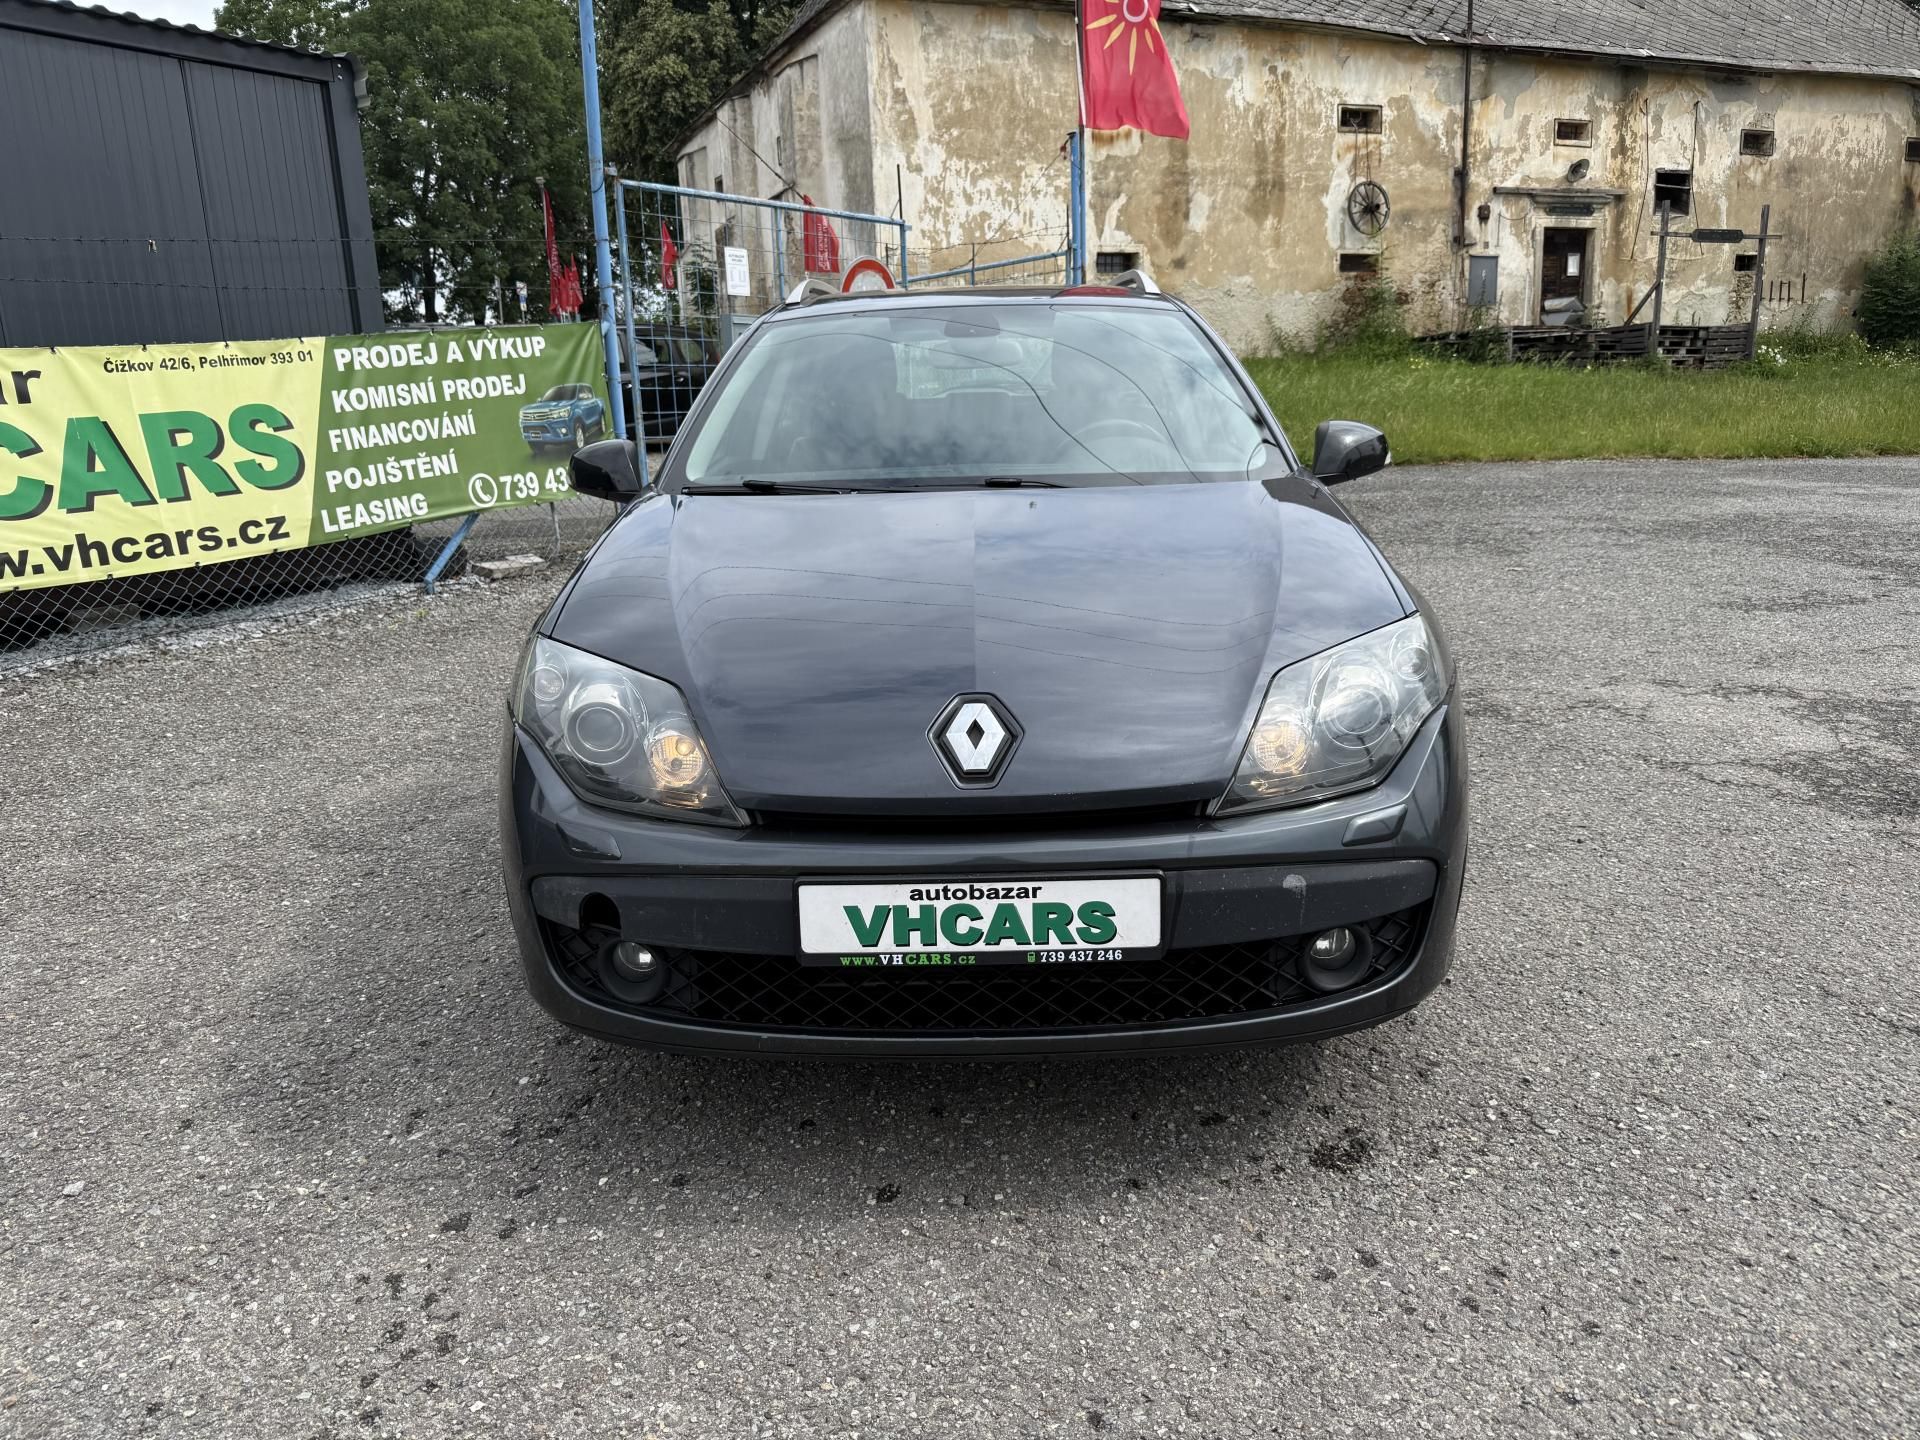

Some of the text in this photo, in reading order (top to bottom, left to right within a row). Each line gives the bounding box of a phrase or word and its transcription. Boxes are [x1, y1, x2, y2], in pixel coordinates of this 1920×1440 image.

[103, 350, 314, 374] Čížkov 42/6, Pelhřimov 393 01
[334, 334, 545, 372] PRODEJ A VÝKUP
[331, 373, 526, 413] KOMISNÍ PRODEJ
[328, 408, 476, 453] FINANCOVÁNÍ
[325, 448, 459, 493] POJIŠTĚNÍ
[499, 471, 539, 501] 739
[320, 493, 429, 533] LEASING
[909, 884, 1042, 901] autobazar
[843, 901, 1118, 948] VHCARS
[840, 954, 976, 967] www.VHCARS.cz
[1040, 950, 1123, 963] 739 437 246
